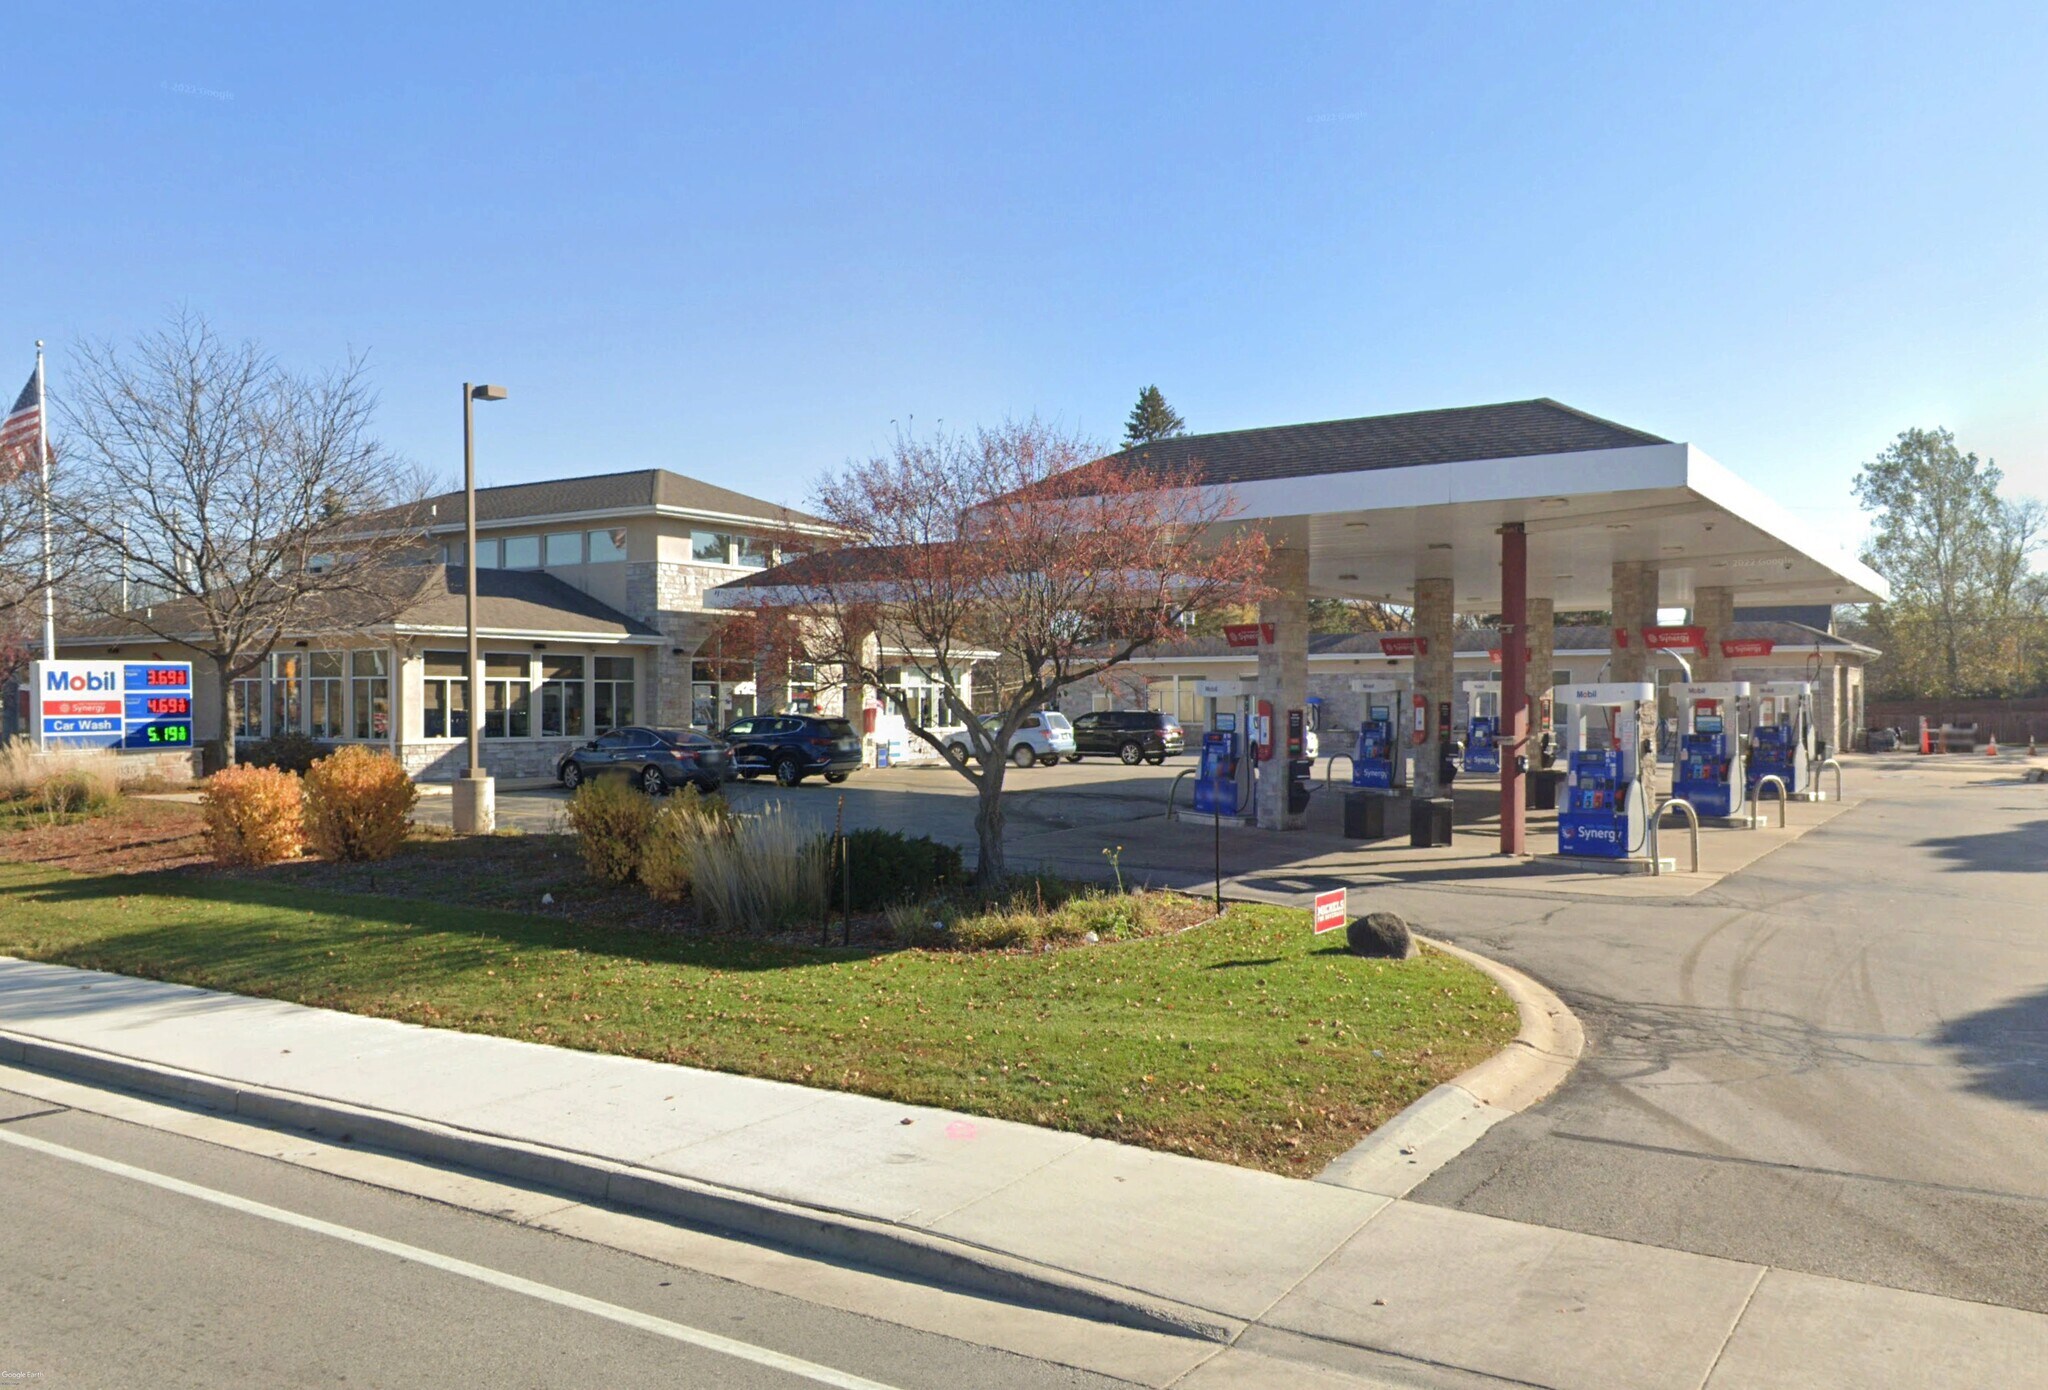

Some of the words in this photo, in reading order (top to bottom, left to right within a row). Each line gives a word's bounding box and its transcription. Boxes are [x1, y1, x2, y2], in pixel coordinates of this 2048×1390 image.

[47, 670, 115, 691] Mobil
[1576, 690, 1597, 698] Mobil
[72, 703, 106, 715] Synergy
[53, 721, 75, 731] Car
[78, 720, 112, 731] Wash
[1364, 768, 1388, 780] Synergy
[1578, 826, 1622, 843] Synergy
